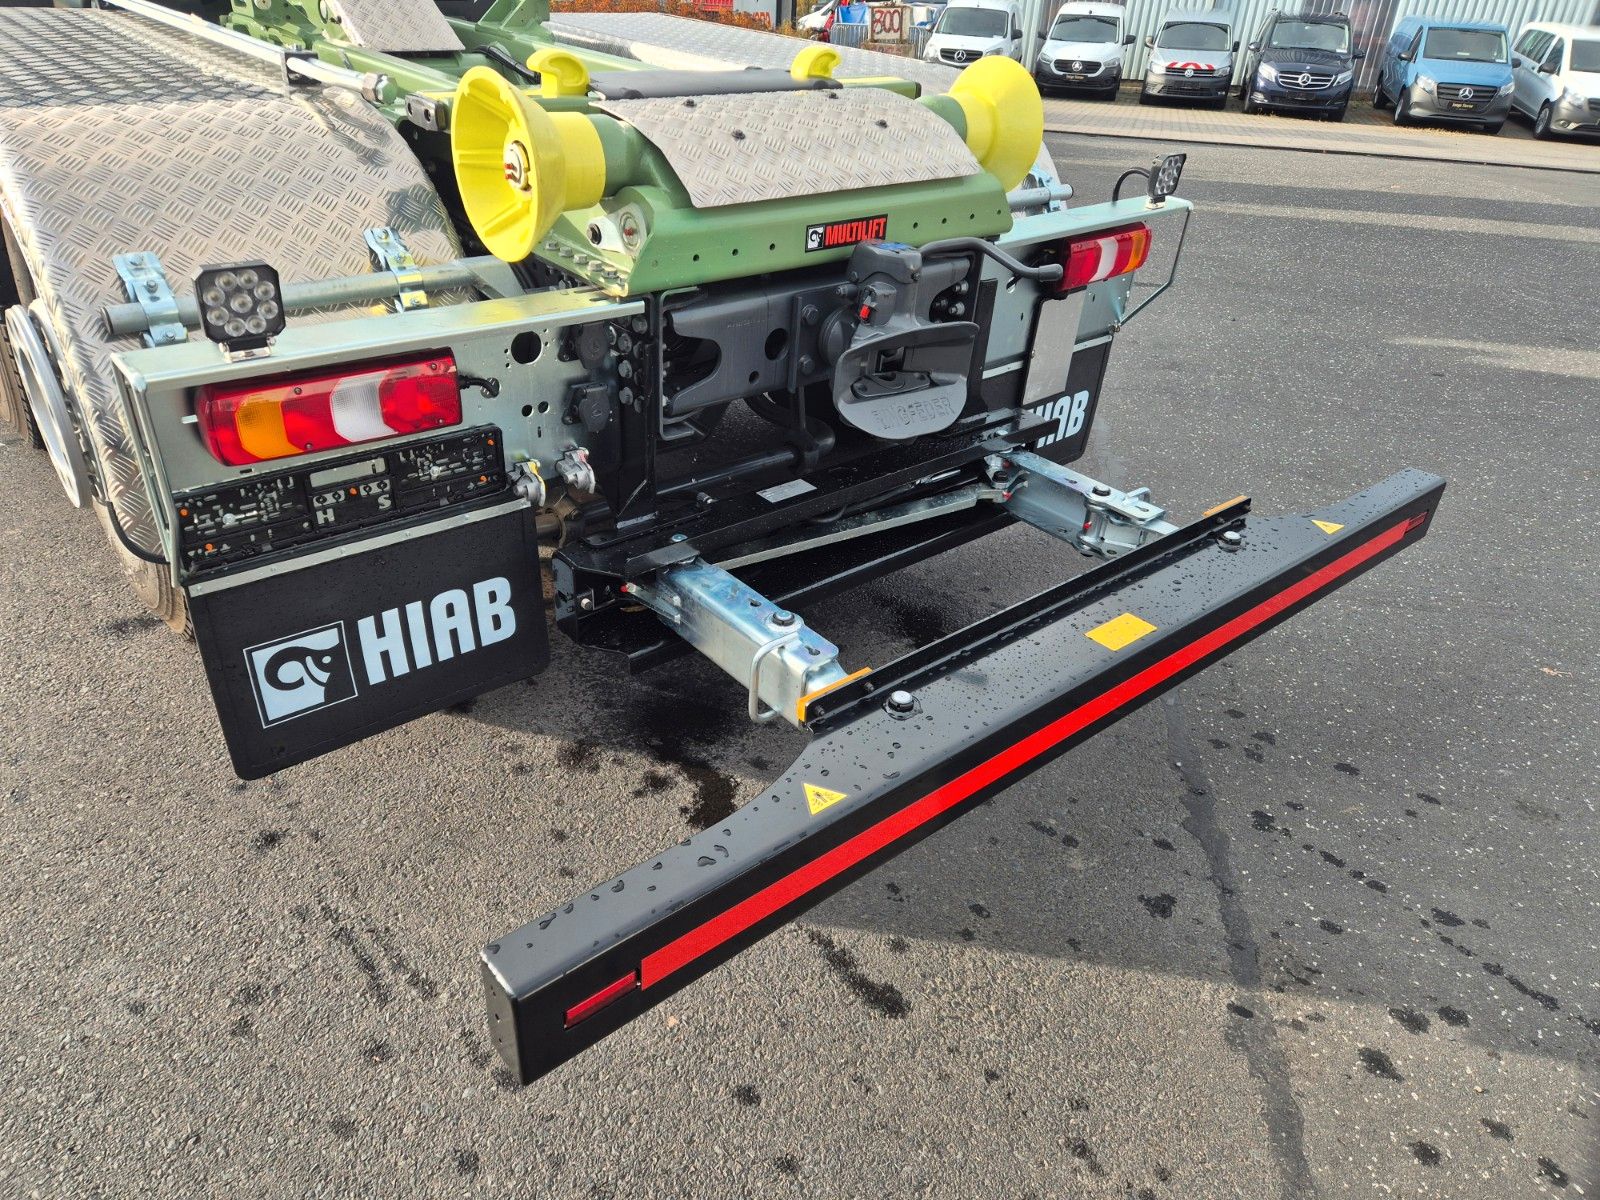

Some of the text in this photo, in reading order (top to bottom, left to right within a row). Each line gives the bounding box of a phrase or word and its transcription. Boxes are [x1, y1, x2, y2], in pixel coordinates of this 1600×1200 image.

[824, 217, 887, 246] MULTILIFT
[1026, 390, 1090, 449] IAB
[356, 576, 518, 687] HIAB
